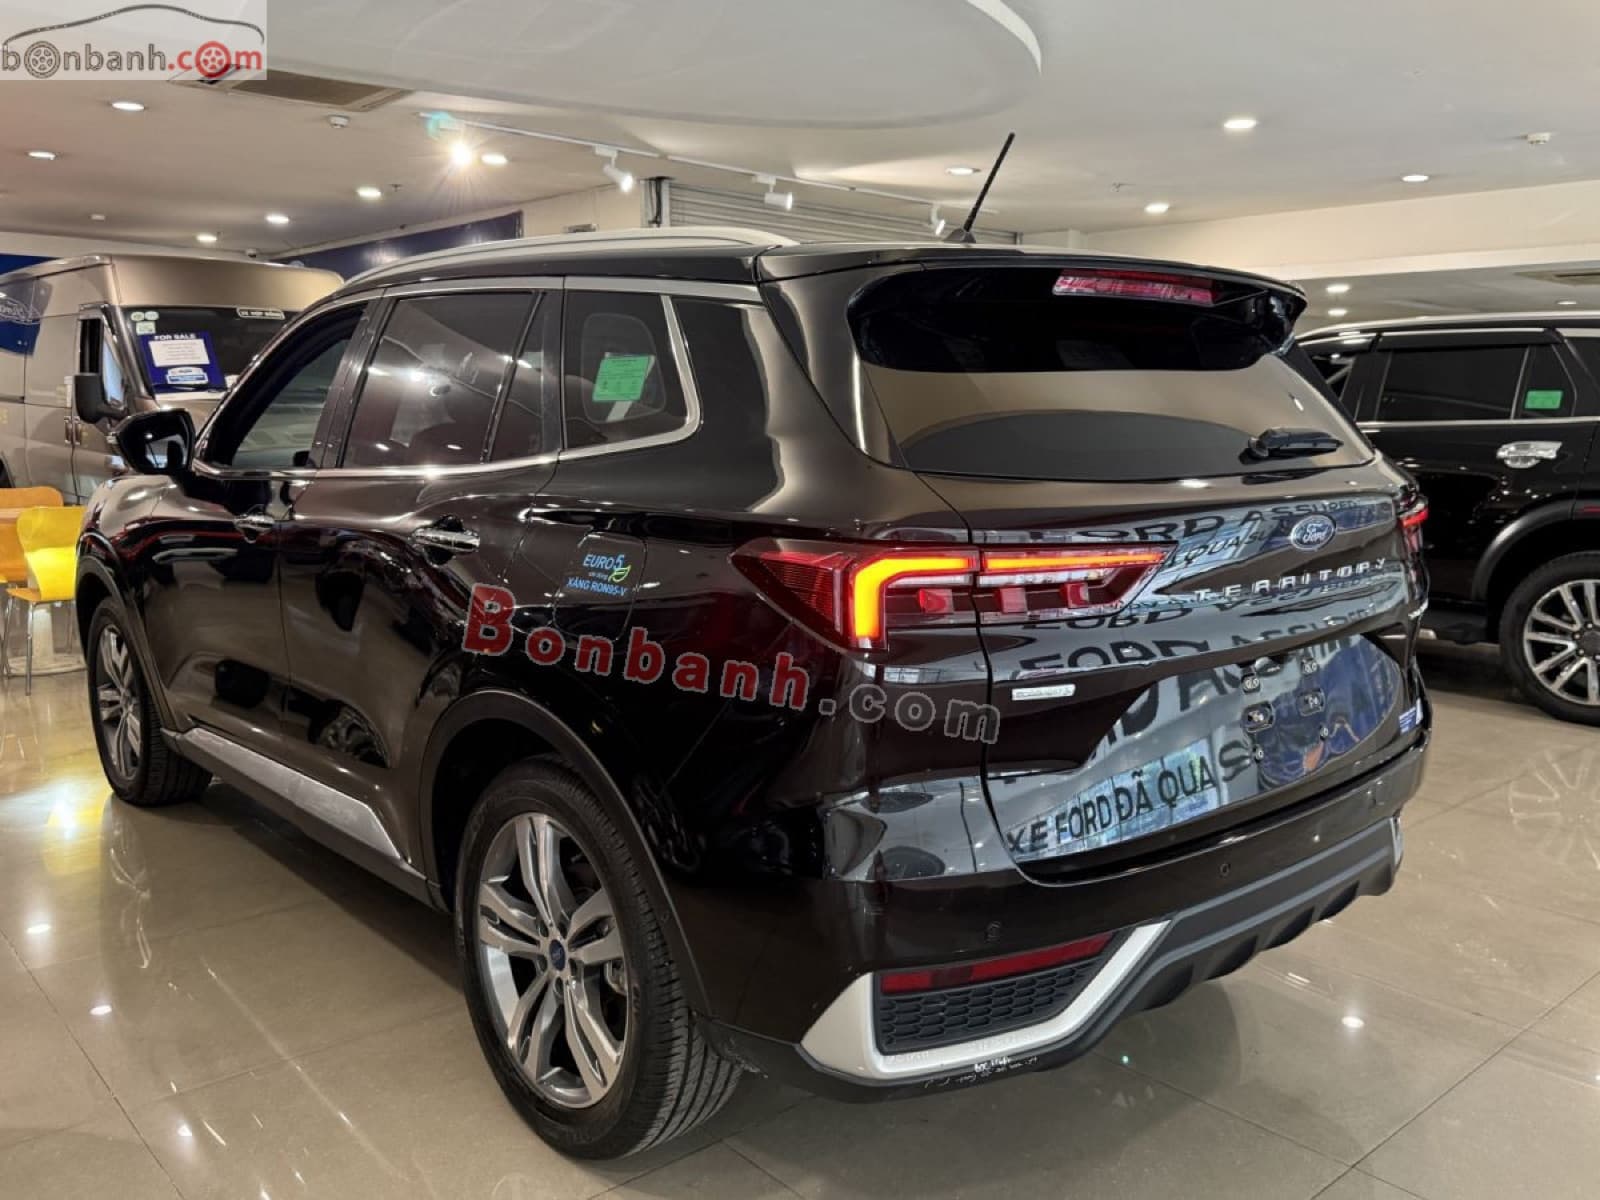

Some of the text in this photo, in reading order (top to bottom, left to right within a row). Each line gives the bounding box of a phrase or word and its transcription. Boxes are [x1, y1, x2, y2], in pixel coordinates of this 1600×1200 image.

[1194, 557, 1387, 601] TERRITORY
[1007, 821, 1048, 853] XE
[1055, 795, 1113, 845] FORD
[1157, 754, 1217, 809] QUA
